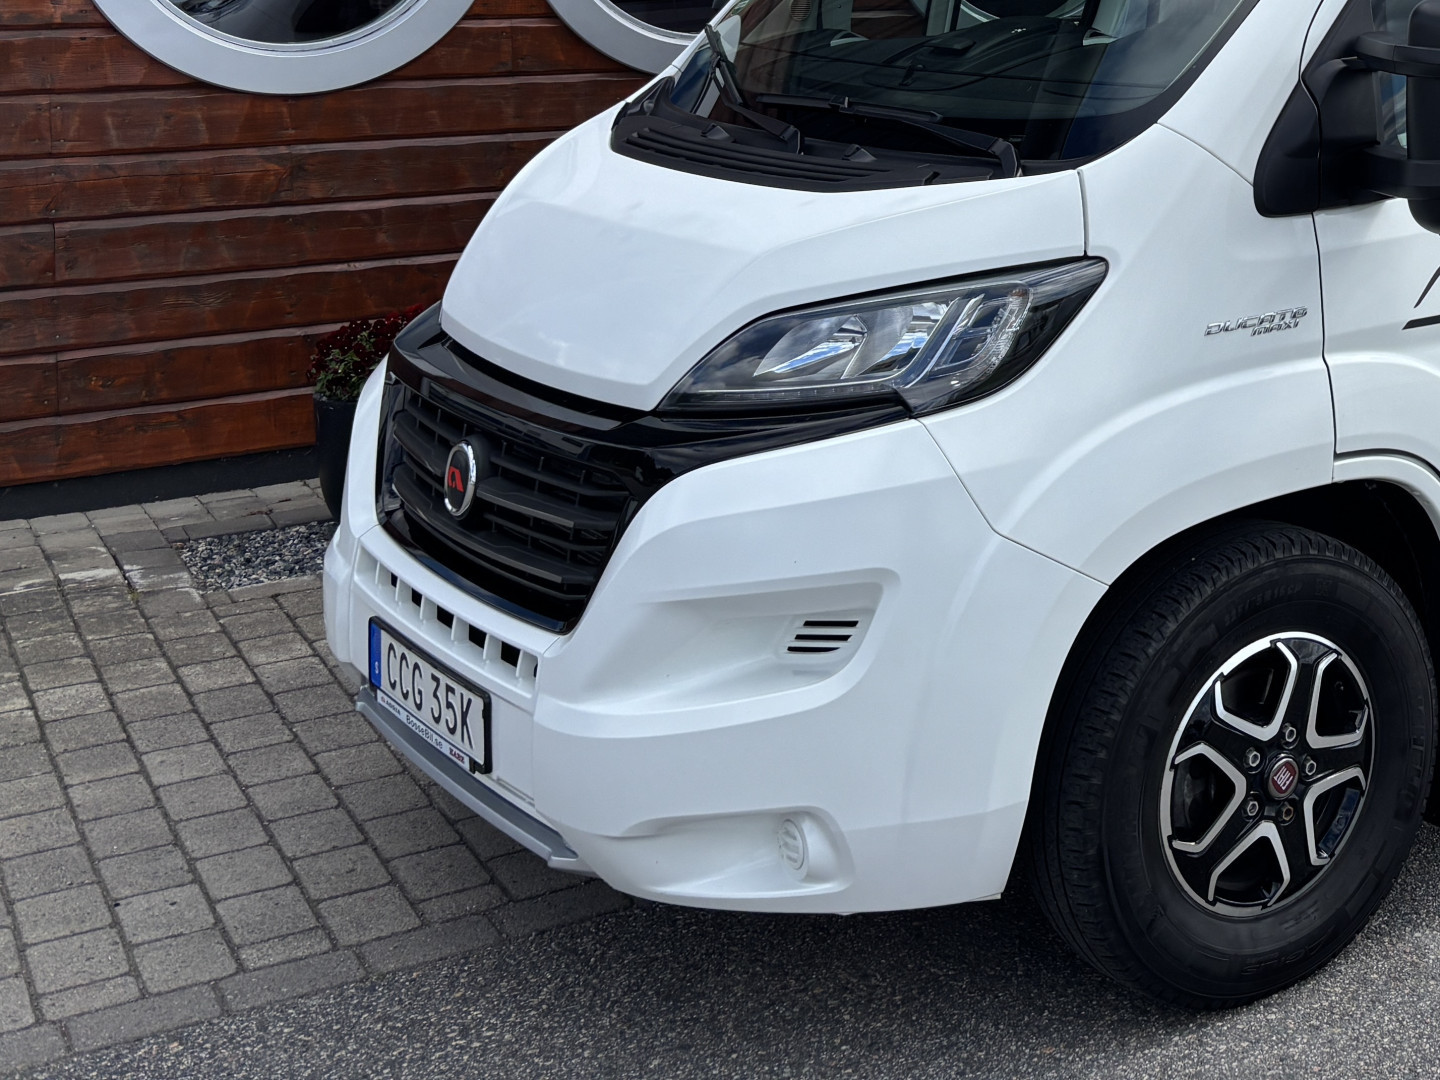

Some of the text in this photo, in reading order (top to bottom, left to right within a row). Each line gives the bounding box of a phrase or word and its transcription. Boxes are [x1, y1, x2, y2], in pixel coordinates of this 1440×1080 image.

[1204, 306, 1308, 336] DUCATO
[387, 642, 475, 750] CCG 35K
[1273, 765, 1294, 790] FIAT
